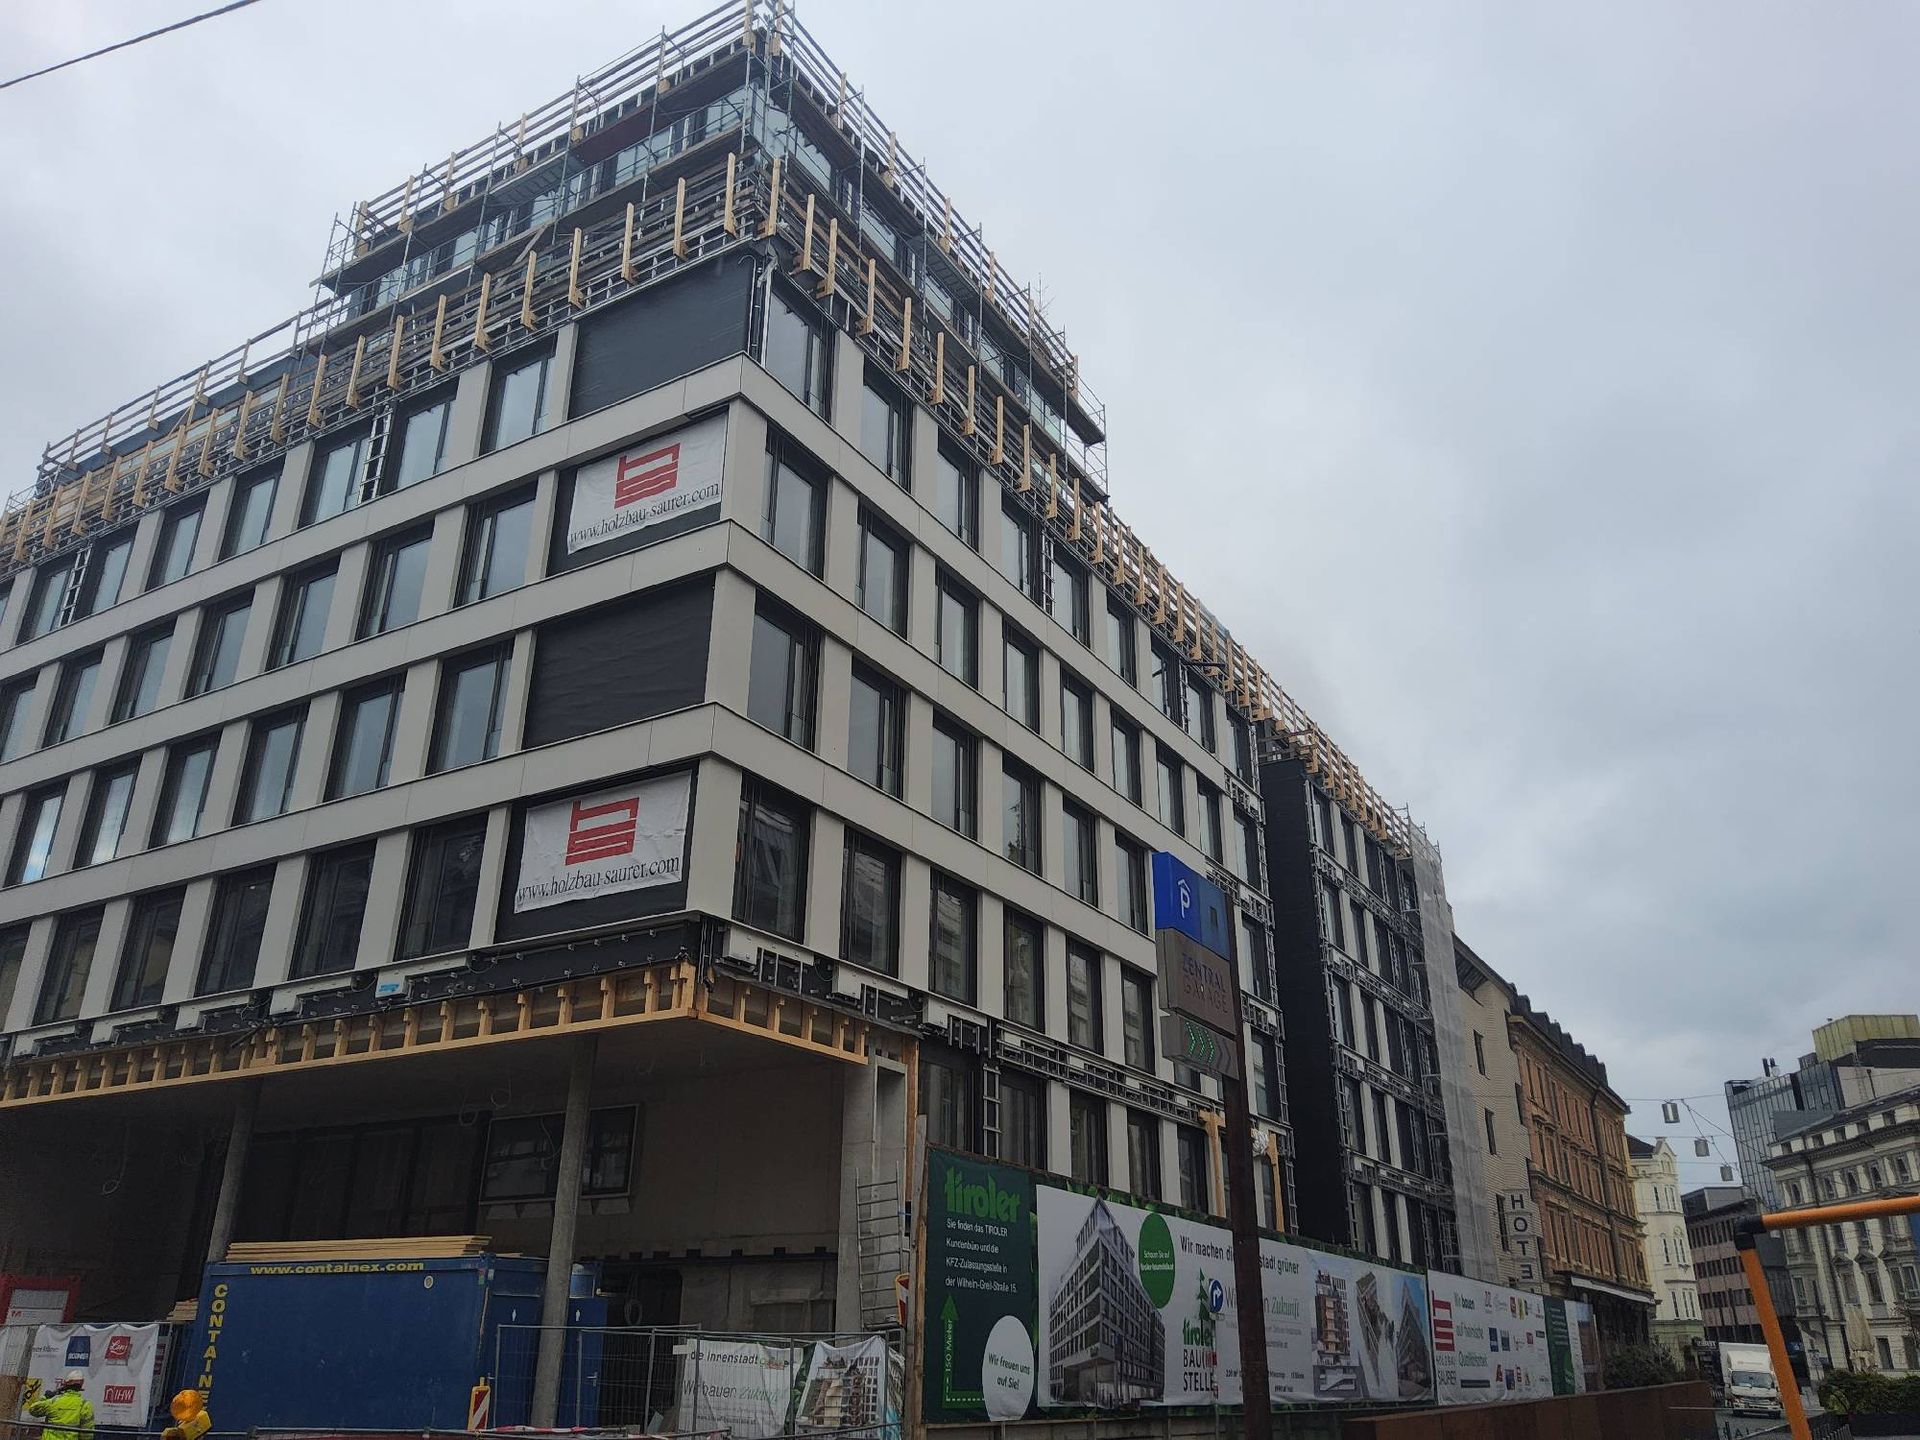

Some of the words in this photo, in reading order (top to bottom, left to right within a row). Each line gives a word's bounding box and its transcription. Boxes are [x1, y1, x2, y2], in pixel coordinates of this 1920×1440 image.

[569, 481, 720, 544] www.holzbau-saurer.com
[517, 856, 680, 902] www.holzbau-saurer.com
[1182, 953, 1226, 994] ZENTRAL
[1184, 975, 1228, 1014] GARAGE
[945, 1166, 1020, 1222] tiroler
[946, 1218, 956, 1229] Sie
[957, 1220, 974, 1232] finden
[974, 1223, 984, 1233] das
[985, 1225, 1008, 1237] TIROLER
[1180, 1234, 1193, 1253] Wir
[1195, 1242, 1223, 1259] machen
[250, 1261, 424, 1275] www.containex.com
[1277, 1258, 1299, 1275] grüner
[945, 1277, 955, 1287] der
[1225, 1286, 1237, 1309] Wi
[198, 1283, 229, 1409] CONTAINE
[690, 1350, 704, 1361] de
[988, 1353, 999, 1366] Wir
[1000, 1354, 1019, 1372] freuen
[1020, 1363, 1030, 1375] uns
[997, 1375, 1007, 1388] auf
[1008, 1377, 1020, 1390] Sie!
[1183, 1372, 1215, 1392] STELLE
